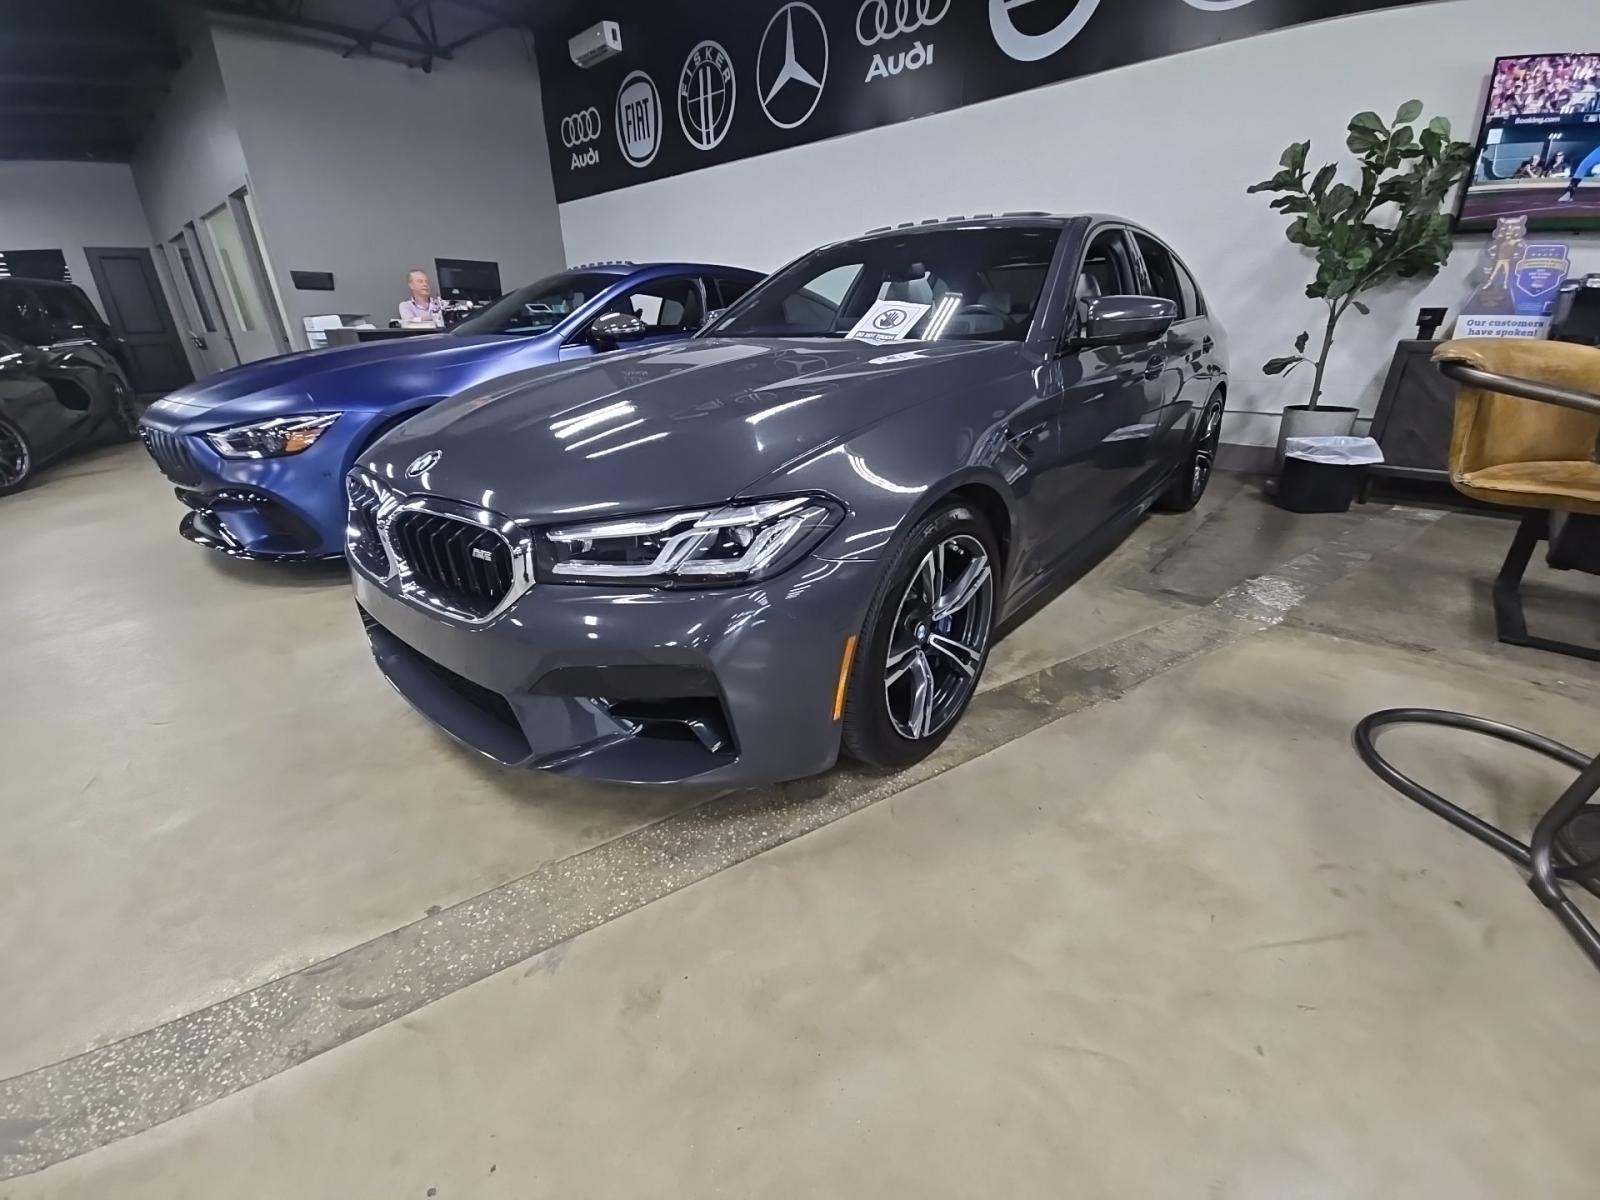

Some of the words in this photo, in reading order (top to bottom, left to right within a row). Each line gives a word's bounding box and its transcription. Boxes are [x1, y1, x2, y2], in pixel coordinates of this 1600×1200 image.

[681, 46, 731, 97] FISKER
[864, 40, 934, 83] Audi
[624, 97, 651, 144] FIAT
[570, 147, 599, 170] Audi
[1467, 319, 1487, 327] Our
[1488, 319, 1544, 328] customers
[1467, 328, 1493, 336] have
[1495, 328, 1538, 338] spoken!
